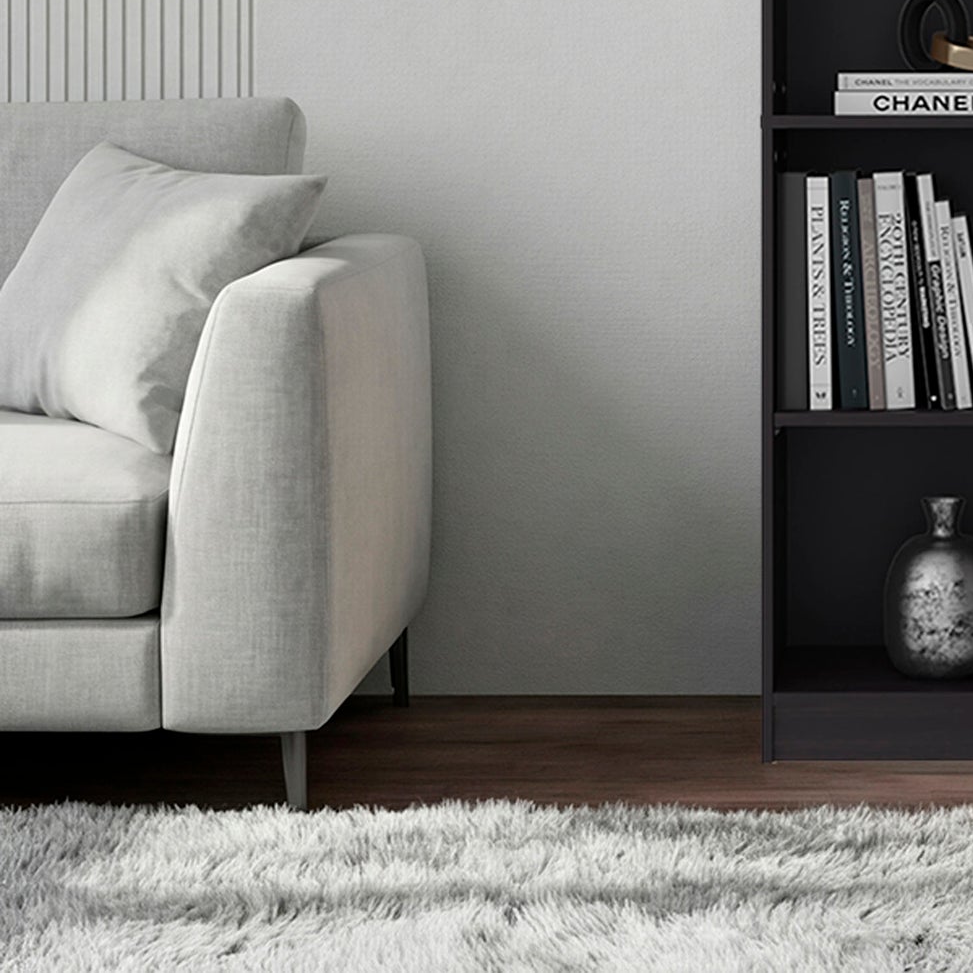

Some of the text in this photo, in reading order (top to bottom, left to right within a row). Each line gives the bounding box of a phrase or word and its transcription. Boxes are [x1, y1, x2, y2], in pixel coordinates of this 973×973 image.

[854, 78, 893, 87] CHANEL
[894, 78, 911, 86] THE
[912, 78, 967, 86] VOCABULARY
[811, 207, 825, 281] PLANTS
[878, 213, 897, 362] ENCYCLOPEDIA
[895, 271, 910, 359] CENTURY
[813, 307, 826, 366] TREES
